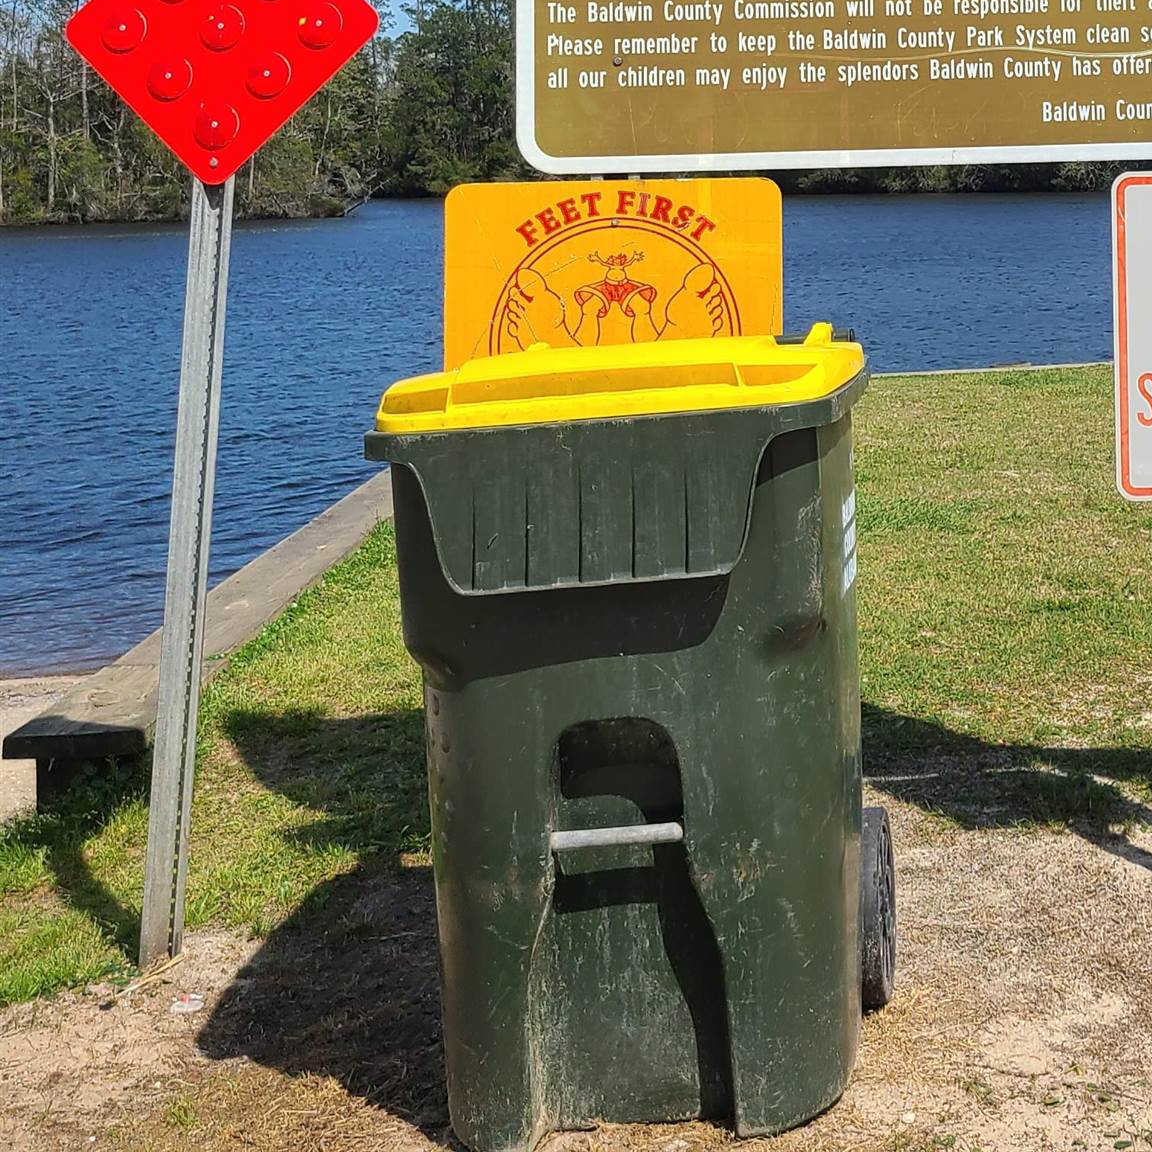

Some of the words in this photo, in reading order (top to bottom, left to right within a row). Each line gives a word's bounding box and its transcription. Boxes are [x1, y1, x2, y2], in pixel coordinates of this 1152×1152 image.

[547, 2, 577, 23] The
[587, 0, 653, 23] Baldwin
[663, 0, 723, 25] County
[547, 32, 603, 56] Please
[614, 33, 698, 55] remember
[710, 32, 727, 53] to
[738, 31, 777, 57] keep
[788, 30, 815, 51] the
[823, 28, 887, 50] Baldwin
[897, 27, 956, 53] County
[966, 26, 1004, 47] Park
[1015, 24, 1076, 48] System
[1086, 23, 1130, 44] clean
[547, 67, 568, 89] all
[578, 71, 607, 88] our
[617, 65, 685, 87] children
[695, 68, 731, 90] may
[742, 62, 787, 91] enjoy
[798, 62, 826, 83] the
[837, 60, 919, 87] splendors
[930, 58, 993, 80] Baldwin
[1003, 56, 1062, 82] County
[1072, 55, 1101, 76] has
[1042, 100, 1106, 122] Baldwin
[515, 191, 602, 248] FEET
[615, 190, 716, 242] FIRST
